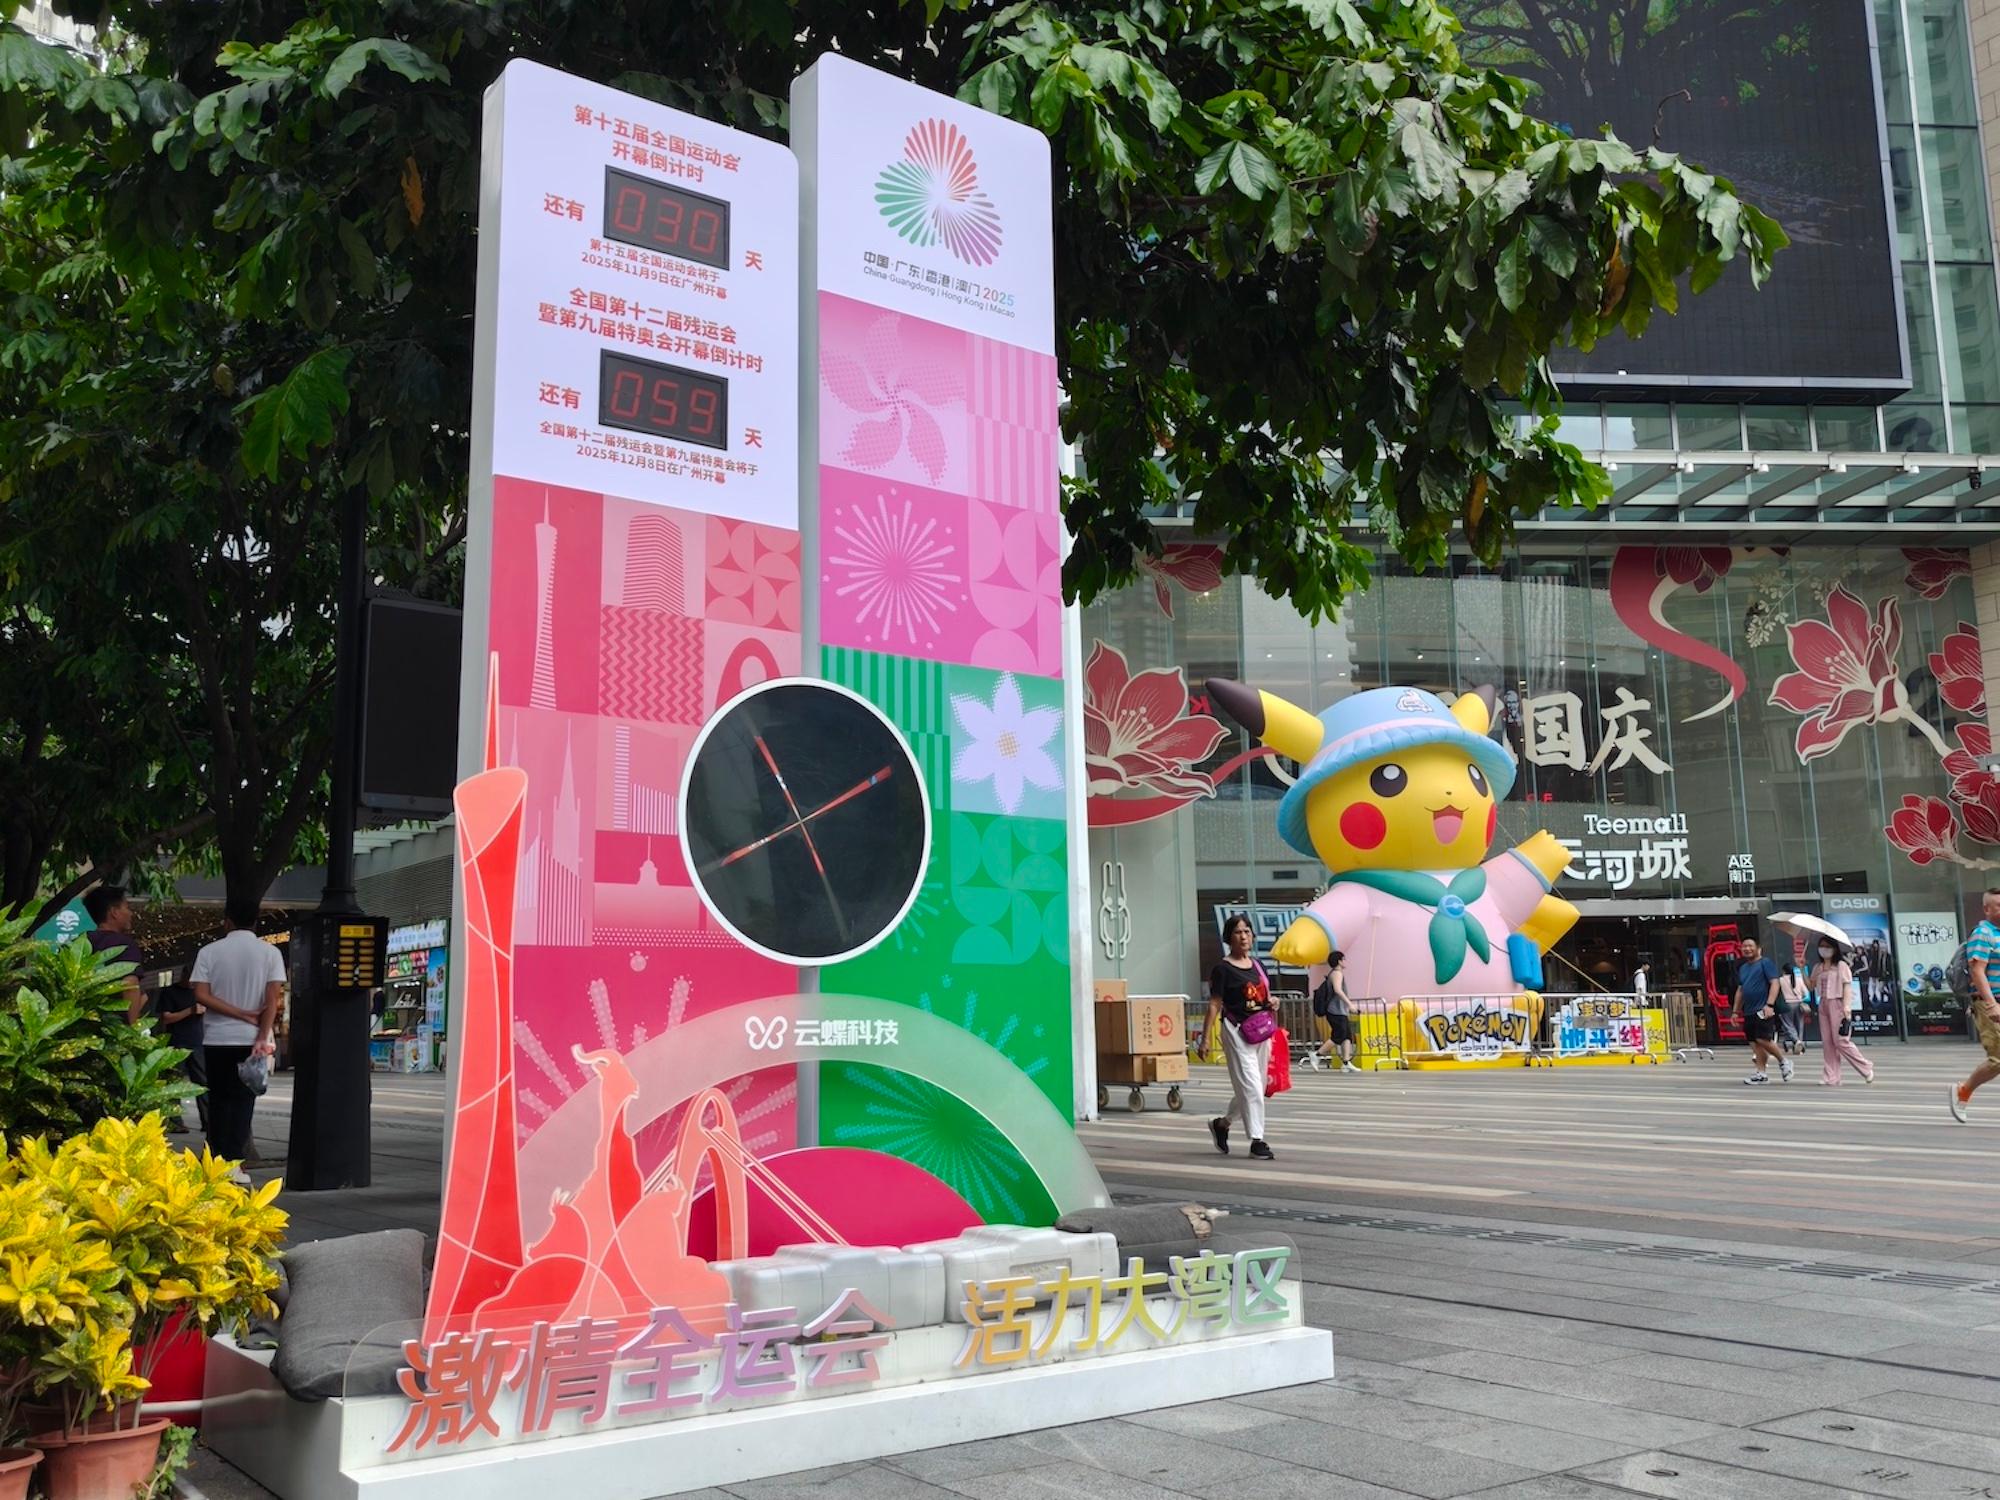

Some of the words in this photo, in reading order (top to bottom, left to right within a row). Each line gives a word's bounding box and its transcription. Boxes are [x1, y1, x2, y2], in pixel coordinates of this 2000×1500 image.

[574, 104, 740, 172] 第十五届全国运动会
[612, 140, 704, 182] 开幕倒计时
[543, 192, 585, 222] 还有
[613, 185, 721, 255] 030
[745, 250, 763, 271] 天
[581, 252, 727, 300] 2025年11月9日在广州开幕
[590, 238, 720, 283] 第十五届全国运动会将于
[569, 287, 737, 345] 全国第十二届残运会
[941, 287, 962, 304] Hong
[964, 295, 984, 311] Kong
[990, 303, 1016, 318] Macao
[983, 287, 1015, 307] 2025
[538, 302, 764, 373] 暨第九届特奥会开幕倒计时
[539, 381, 582, 410] 还有
[610, 370, 718, 435] 059
[744, 427, 763, 449] 天
[539, 420, 759, 476] 全国第十二届残运会暨第九届特奥会将于
[577, 444, 726, 485] 2025年12月8日在广州开幕
[1583, 813, 1689, 835] Teemall
[1728, 854, 1754, 869] A区
[1729, 870, 1755, 883] 南门
[1830, 898, 1879, 909] CASIO
[386, 1287, 896, 1452] 激情全运会
[956, 1245, 1292, 1369] 活力大湾区
